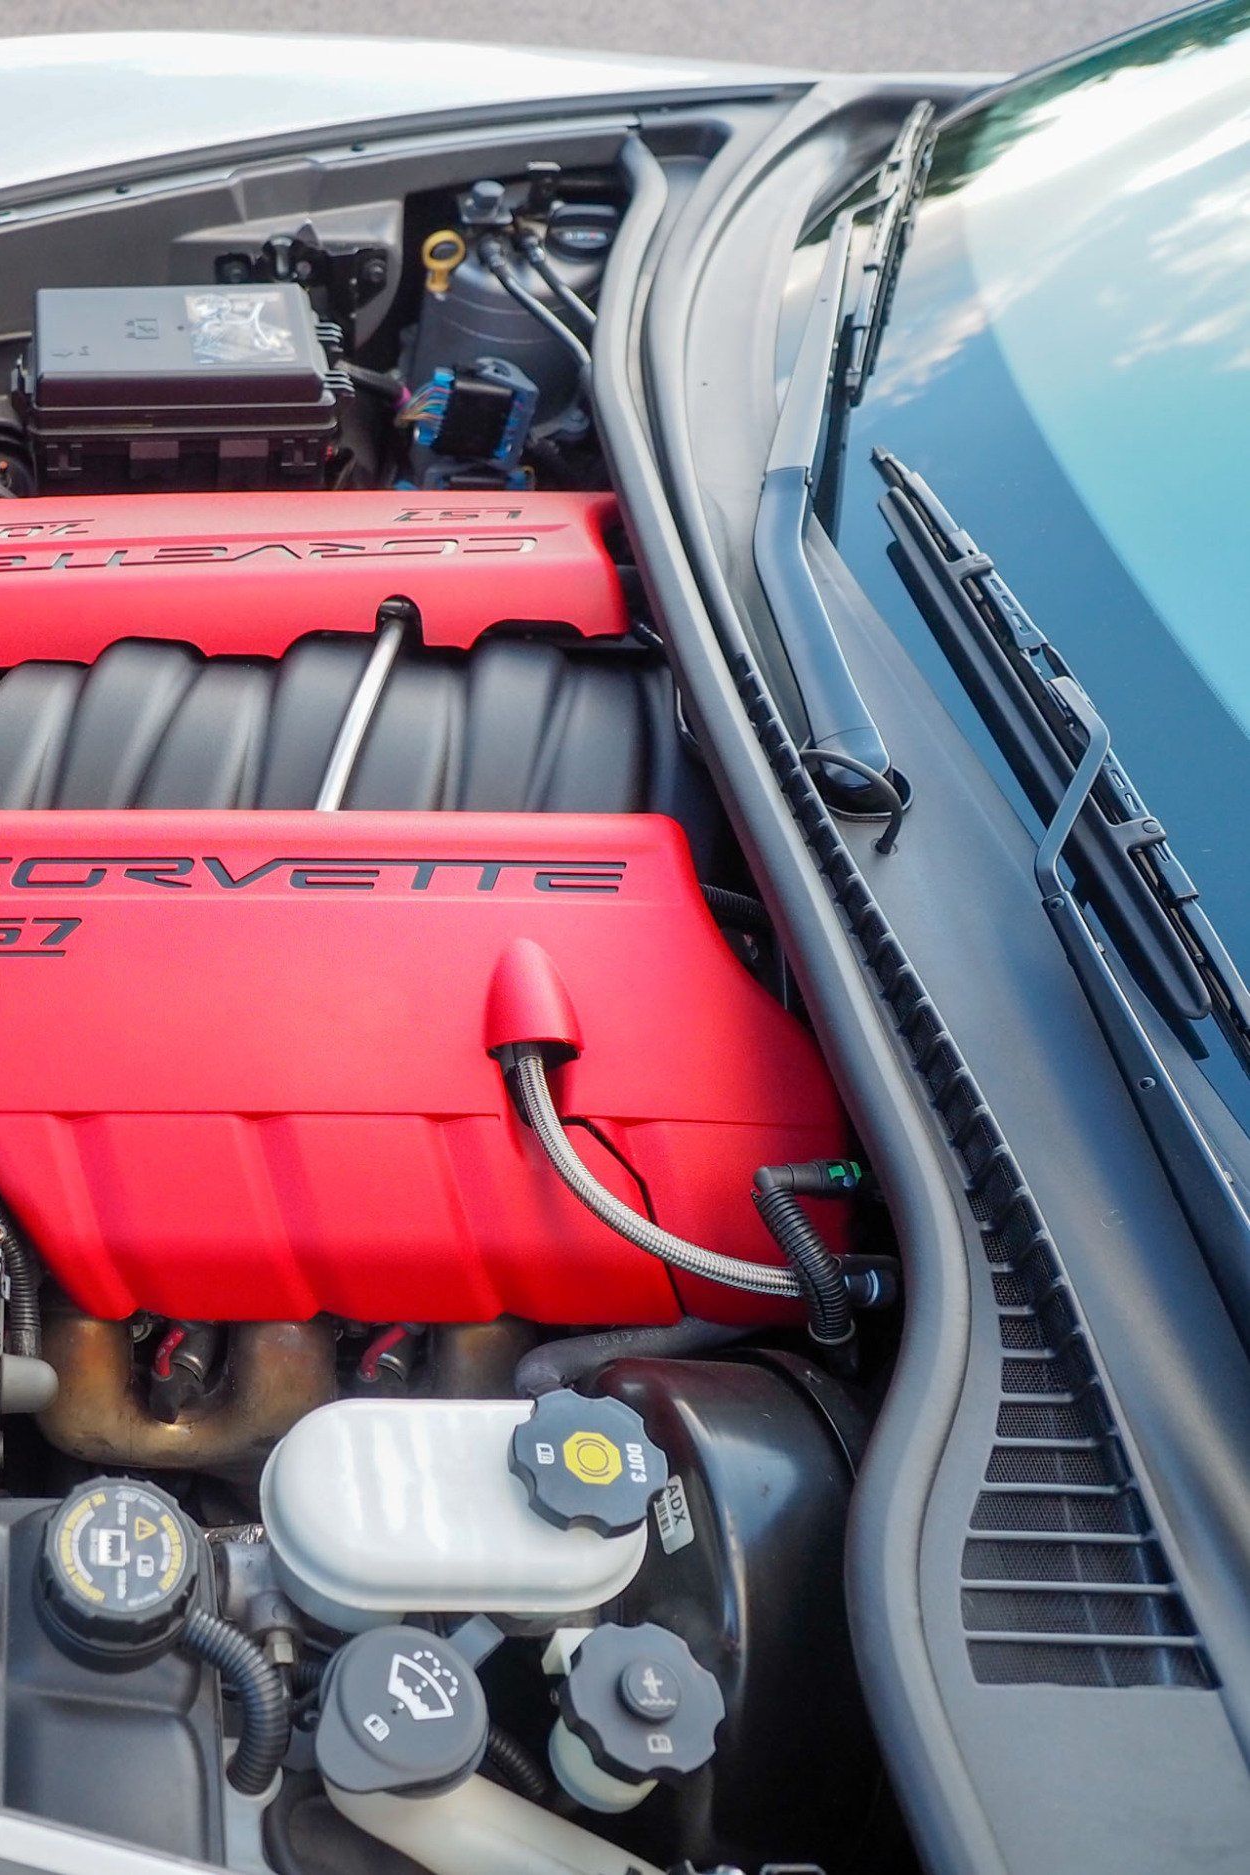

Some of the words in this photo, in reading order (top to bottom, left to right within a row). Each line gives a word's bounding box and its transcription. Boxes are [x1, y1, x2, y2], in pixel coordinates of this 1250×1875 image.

[393, 510, 522, 522] LS7
[625, 1443, 646, 1472] DOT
[632, 1472, 647, 1483] 3
[668, 1485, 686, 1525] ADX
